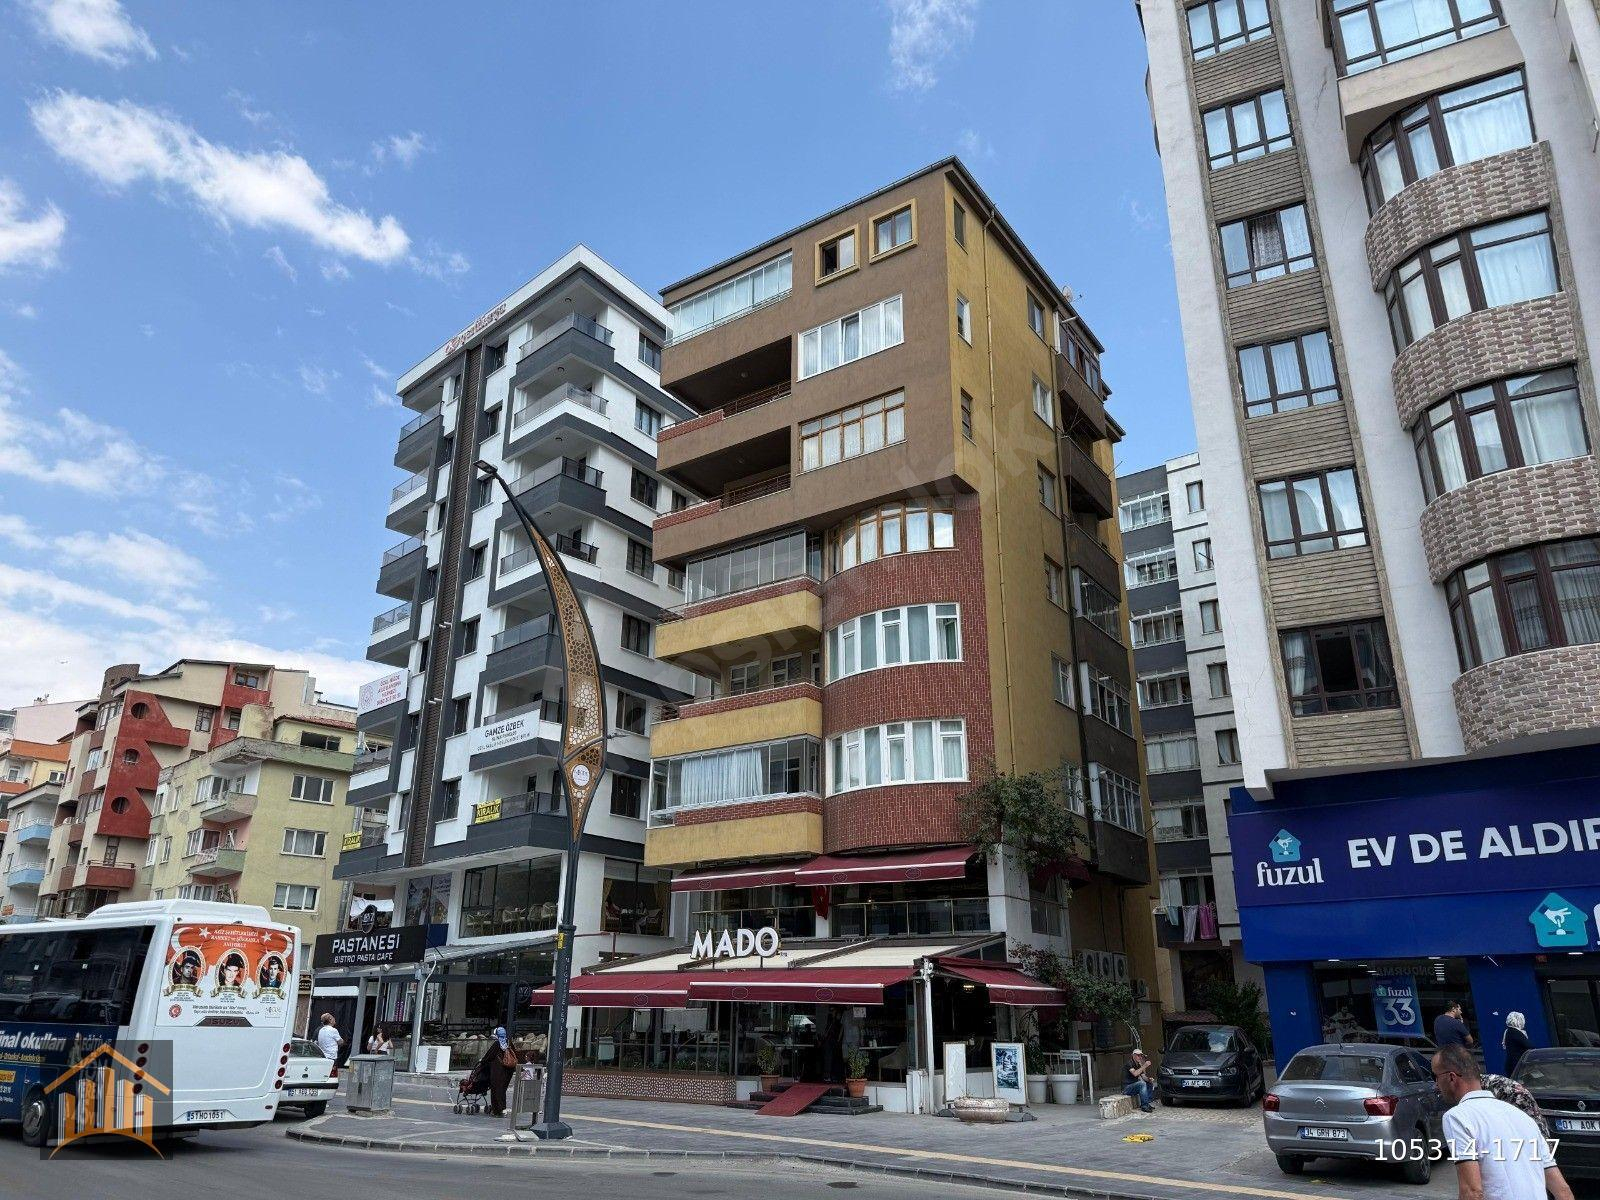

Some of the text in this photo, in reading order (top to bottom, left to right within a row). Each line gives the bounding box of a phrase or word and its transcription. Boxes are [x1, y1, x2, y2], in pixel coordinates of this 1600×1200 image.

[484, 725, 506, 738] GAMZE
[1347, 835, 1397, 869] EV
[1408, 830, 1467, 864] DE
[1256, 858, 1325, 887] fuzul
[690, 926, 779, 958] MADO
[356, 953, 376, 962] PASTA
[376, 952, 394, 961] CAFE
[1387, 986, 1413, 997] fuzul
[1383, 997, 1416, 1026] 33
